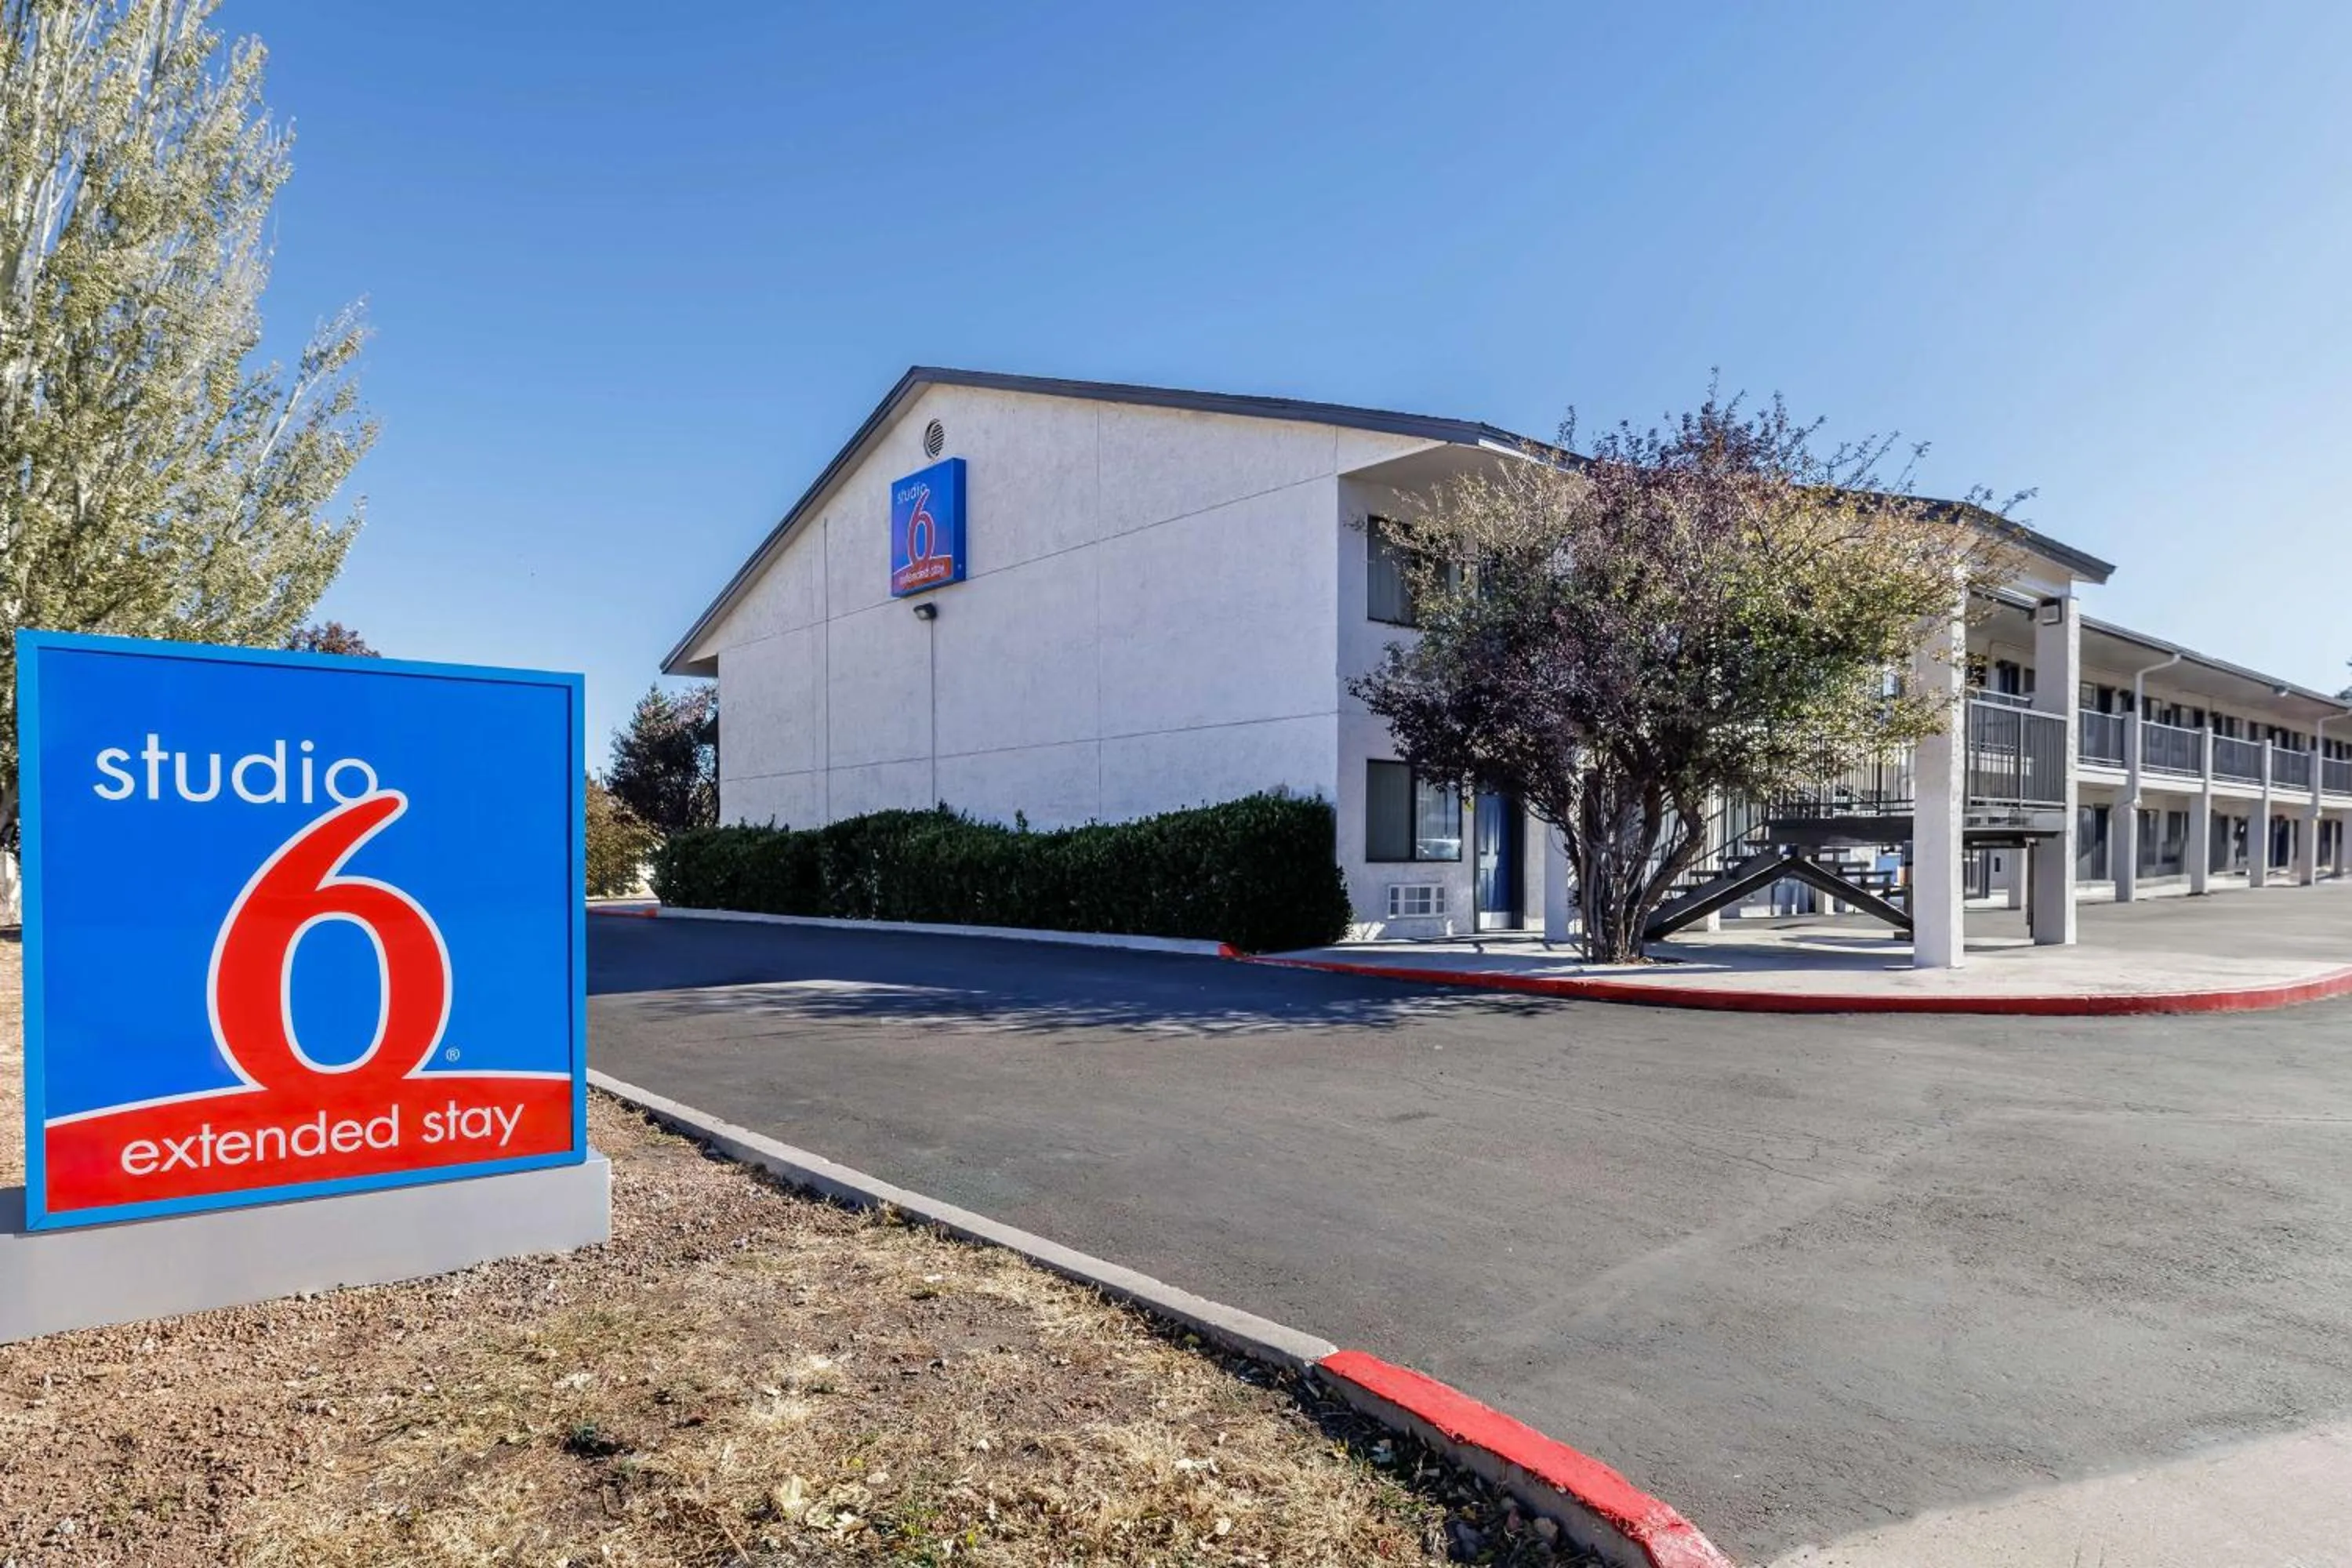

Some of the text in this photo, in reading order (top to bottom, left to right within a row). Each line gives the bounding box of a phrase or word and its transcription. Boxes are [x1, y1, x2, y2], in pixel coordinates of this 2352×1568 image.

[907, 488, 936, 564] 6
[93, 733, 378, 805] studio
[206, 788, 454, 1087] 6
[120, 1101, 524, 1176] extended stay
